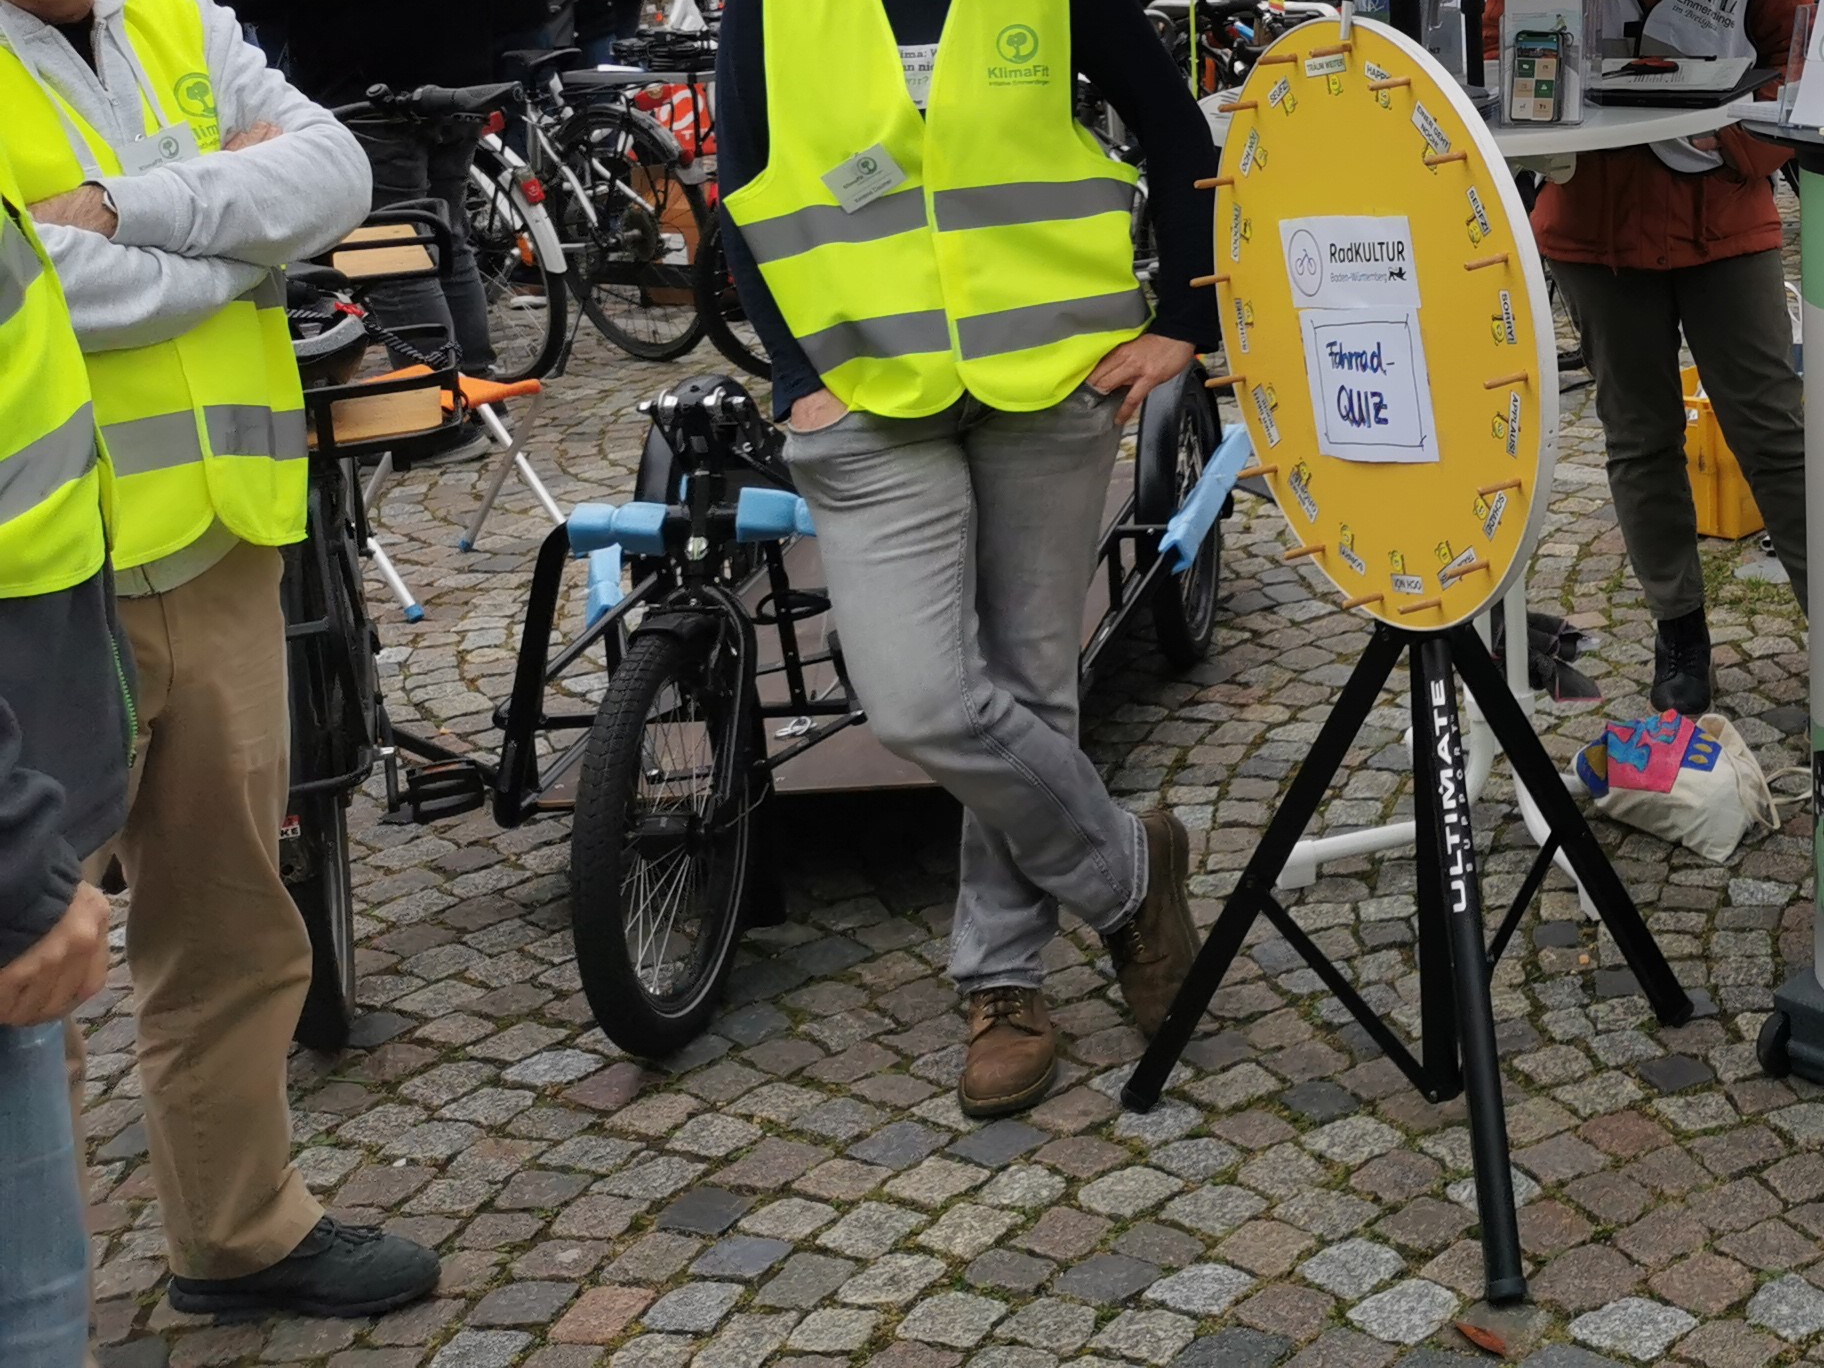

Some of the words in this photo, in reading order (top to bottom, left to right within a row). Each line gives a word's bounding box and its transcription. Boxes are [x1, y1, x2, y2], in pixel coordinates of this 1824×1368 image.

[987, 64, 1050, 81] KlimaFit
[1416, 105, 1434, 128] EINER
[1329, 241, 1406, 264] RadKULTUR
[1337, 384, 1389, 429] QUIZ
[1507, 394, 1519, 455] APPLAUS!
[1430, 679, 1468, 914] ULTIMATE
